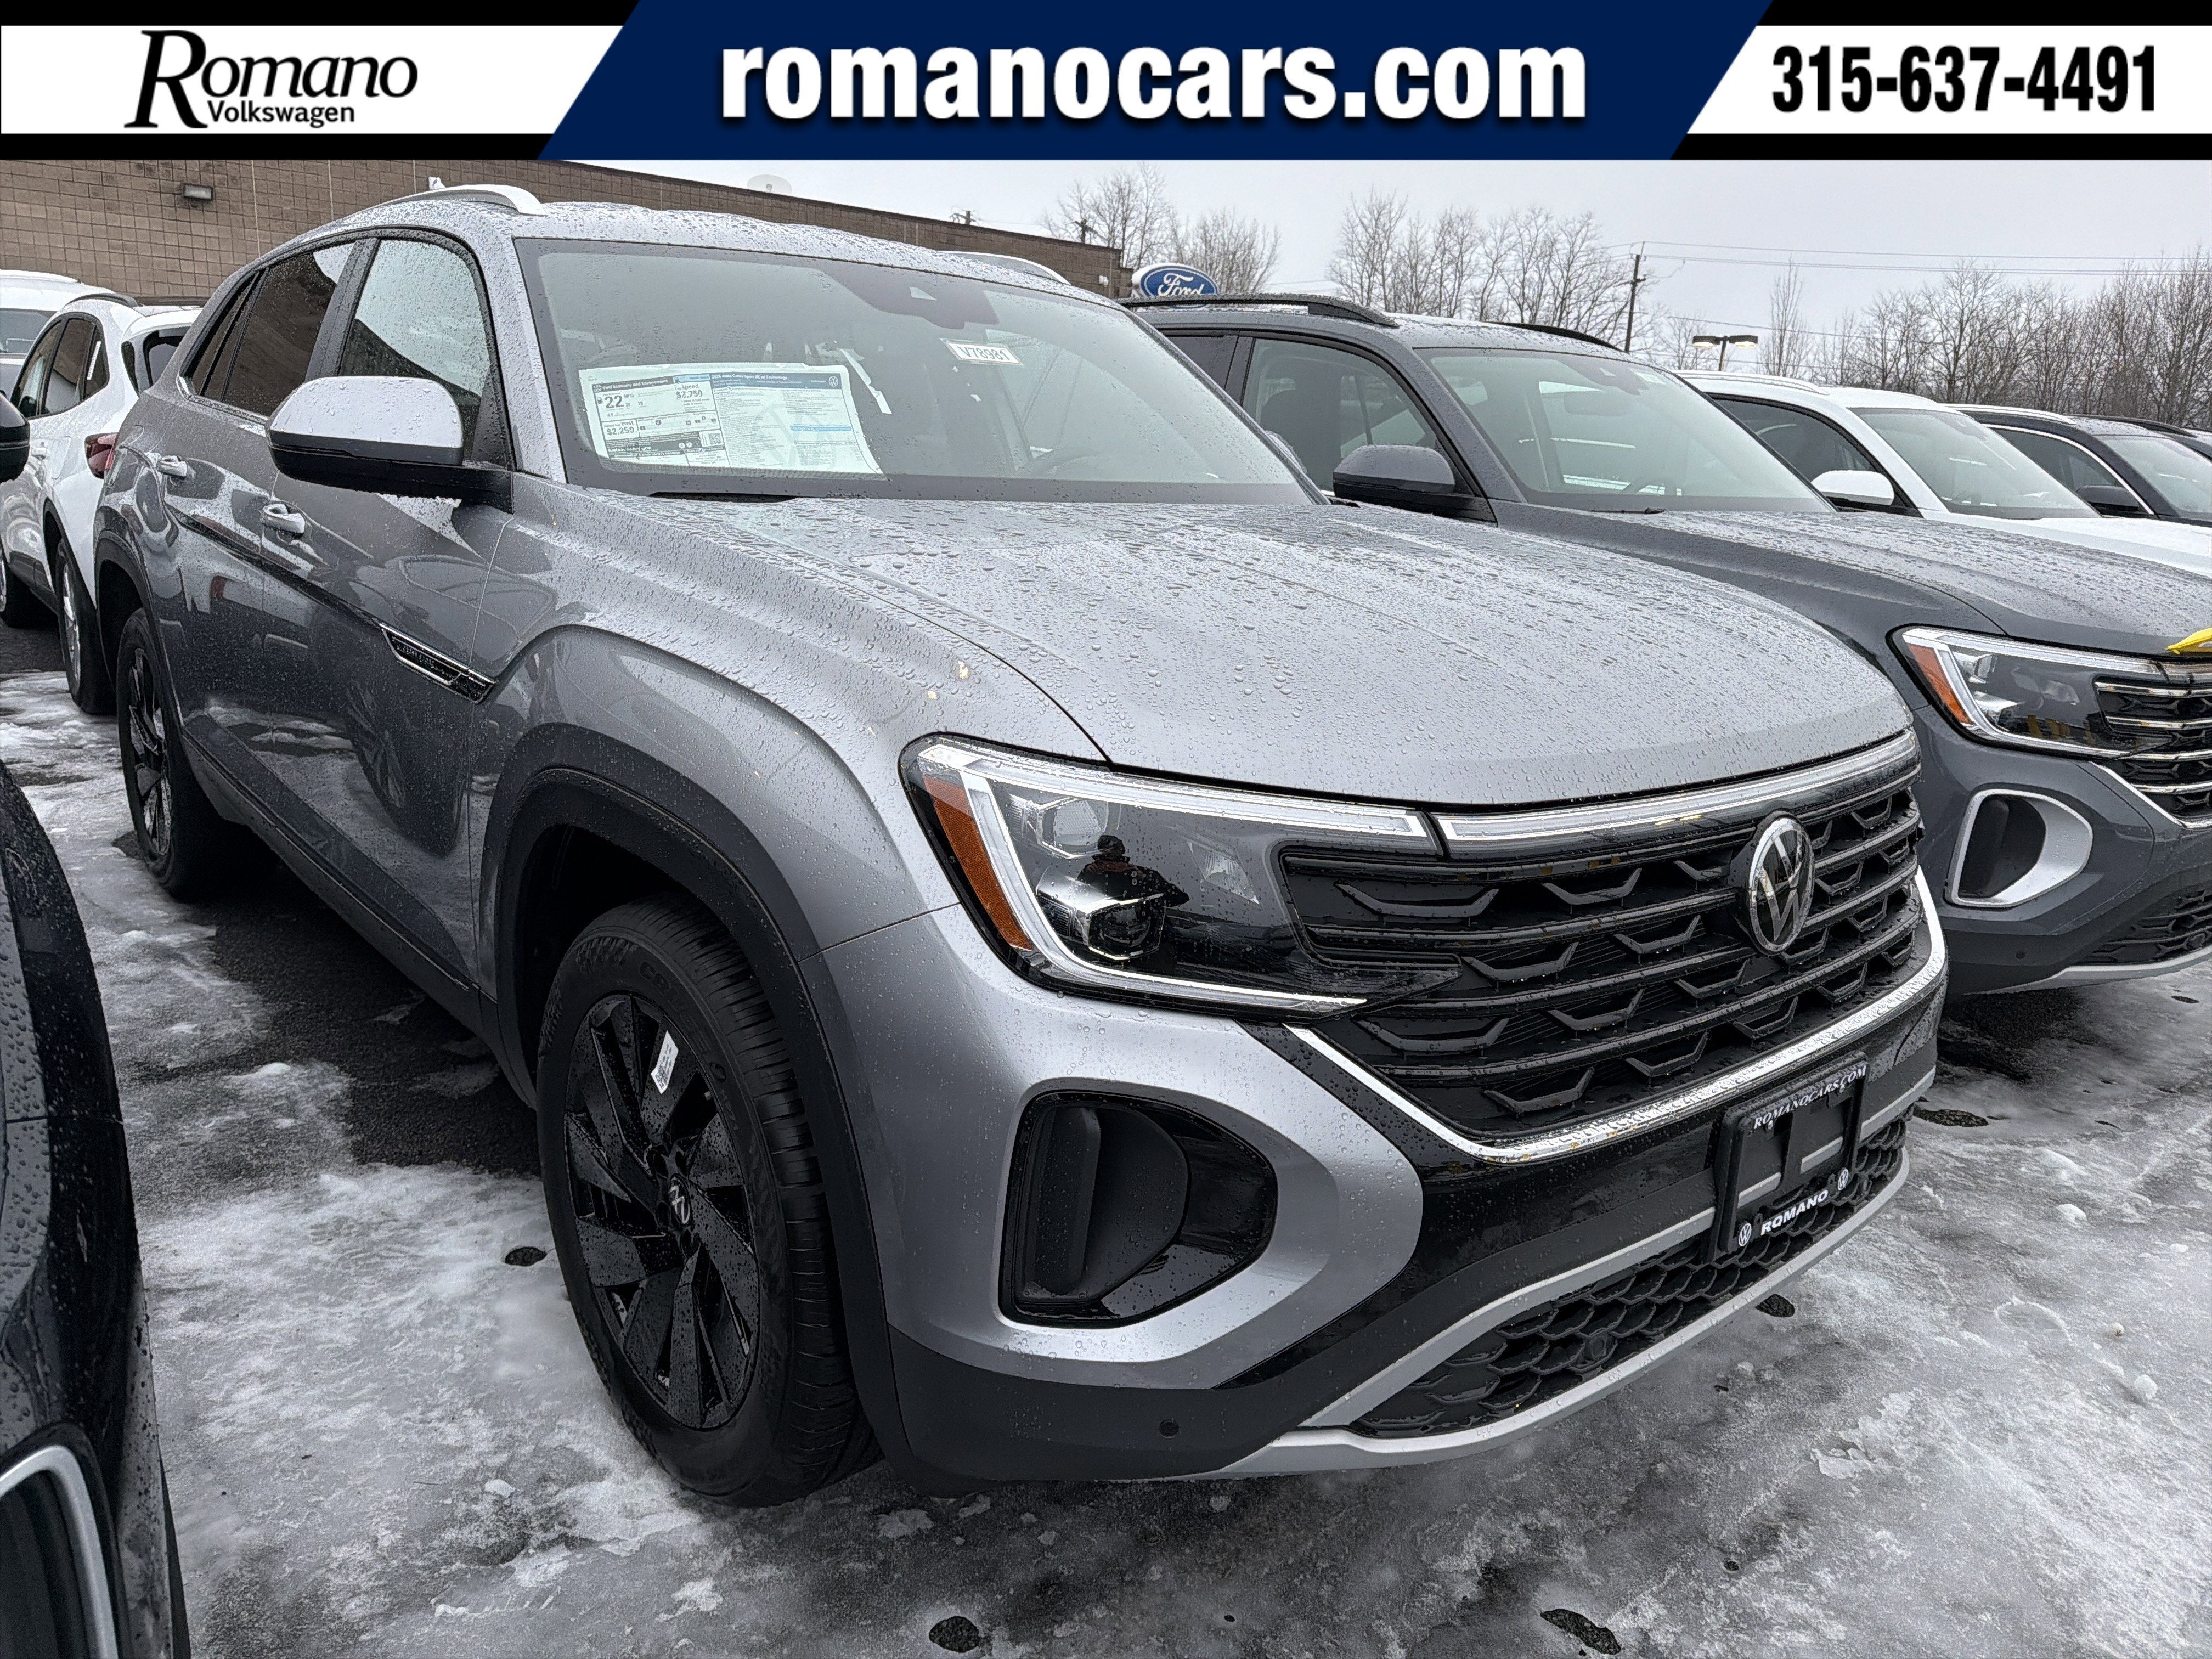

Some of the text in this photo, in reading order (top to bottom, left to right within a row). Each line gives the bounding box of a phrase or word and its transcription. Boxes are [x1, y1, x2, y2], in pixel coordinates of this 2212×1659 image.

[1158, 273, 1205, 296] Ford
[956, 346, 1011, 361] V78981
[675, 390, 703, 399] $2,750
[604, 396, 624, 409] 22
[607, 426, 635, 436] $2,250
[1760, 1190, 1829, 1236] ROMANO
